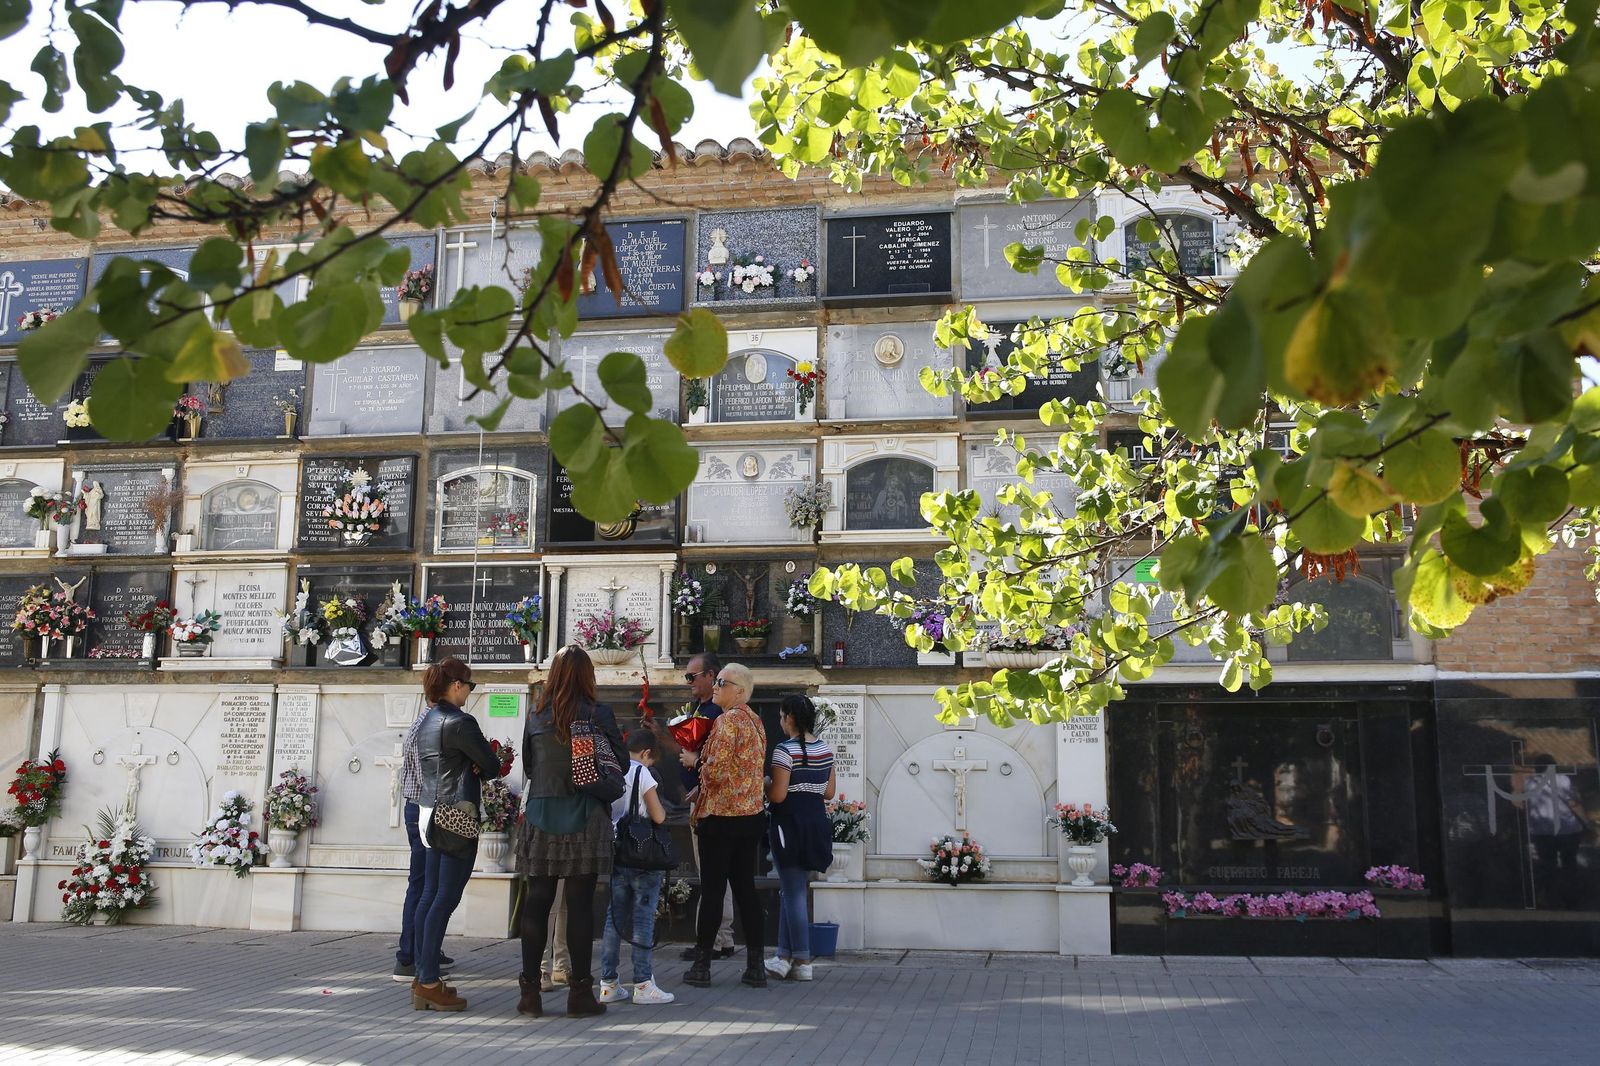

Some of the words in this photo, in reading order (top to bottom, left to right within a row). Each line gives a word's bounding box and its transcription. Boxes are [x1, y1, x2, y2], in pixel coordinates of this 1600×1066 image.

[1021, 214, 1056, 222] ANTONIO
[1022, 236, 1058, 244] ANTONIO
[637, 265, 680, 273] CONTRERAS
[476, 601, 493, 611] MUÑOZ
[1208, 866, 1268, 879] GUERRERO
[1277, 866, 1320, 879] PAREJA
